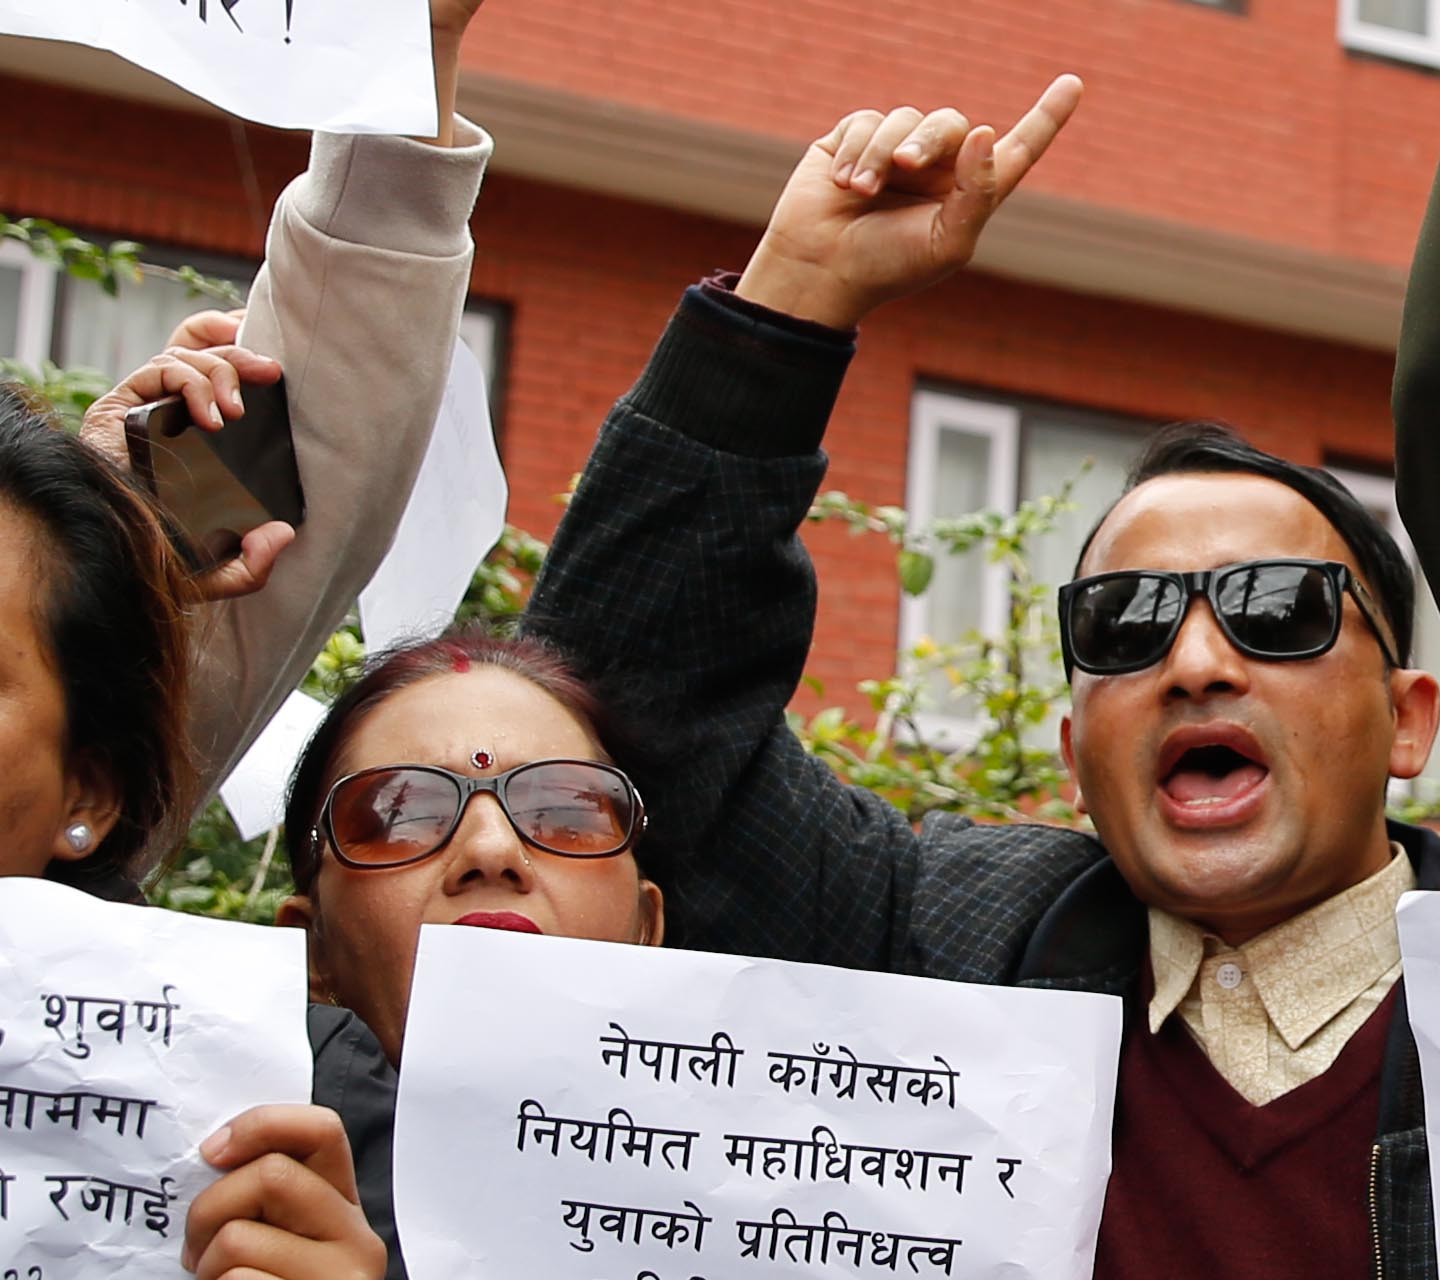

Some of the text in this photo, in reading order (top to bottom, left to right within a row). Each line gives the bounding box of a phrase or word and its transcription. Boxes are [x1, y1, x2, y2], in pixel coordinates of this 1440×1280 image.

[599, 1021, 961, 1110] नेपाली काँग्रेसको
[516, 1098, 1022, 1199] नियमित महाधिवशन र
[560, 1200, 963, 1277] युवाको प्रतिनिधत्व
